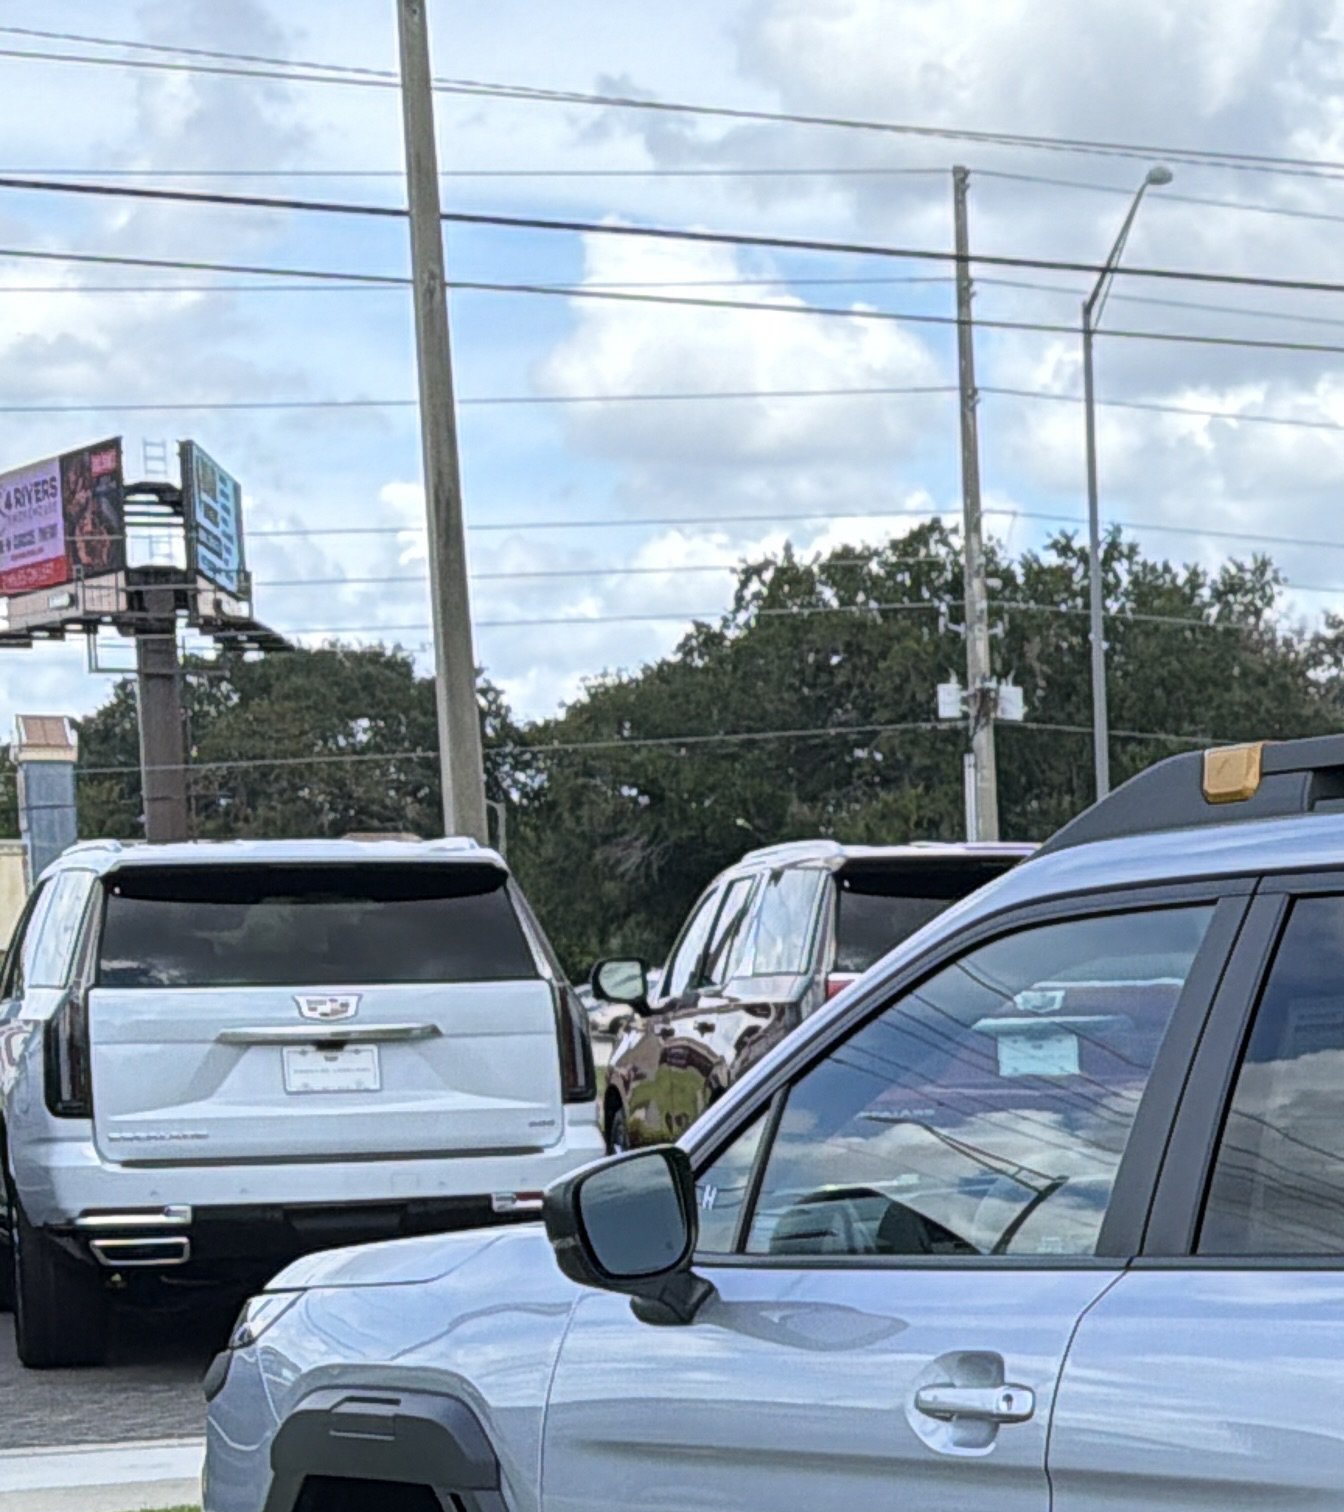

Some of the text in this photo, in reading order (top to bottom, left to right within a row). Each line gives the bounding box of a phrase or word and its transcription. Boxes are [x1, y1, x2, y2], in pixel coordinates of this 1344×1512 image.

[4, 476, 58, 510] 4 RIVERS
[703, 1184, 717, 1211] H
